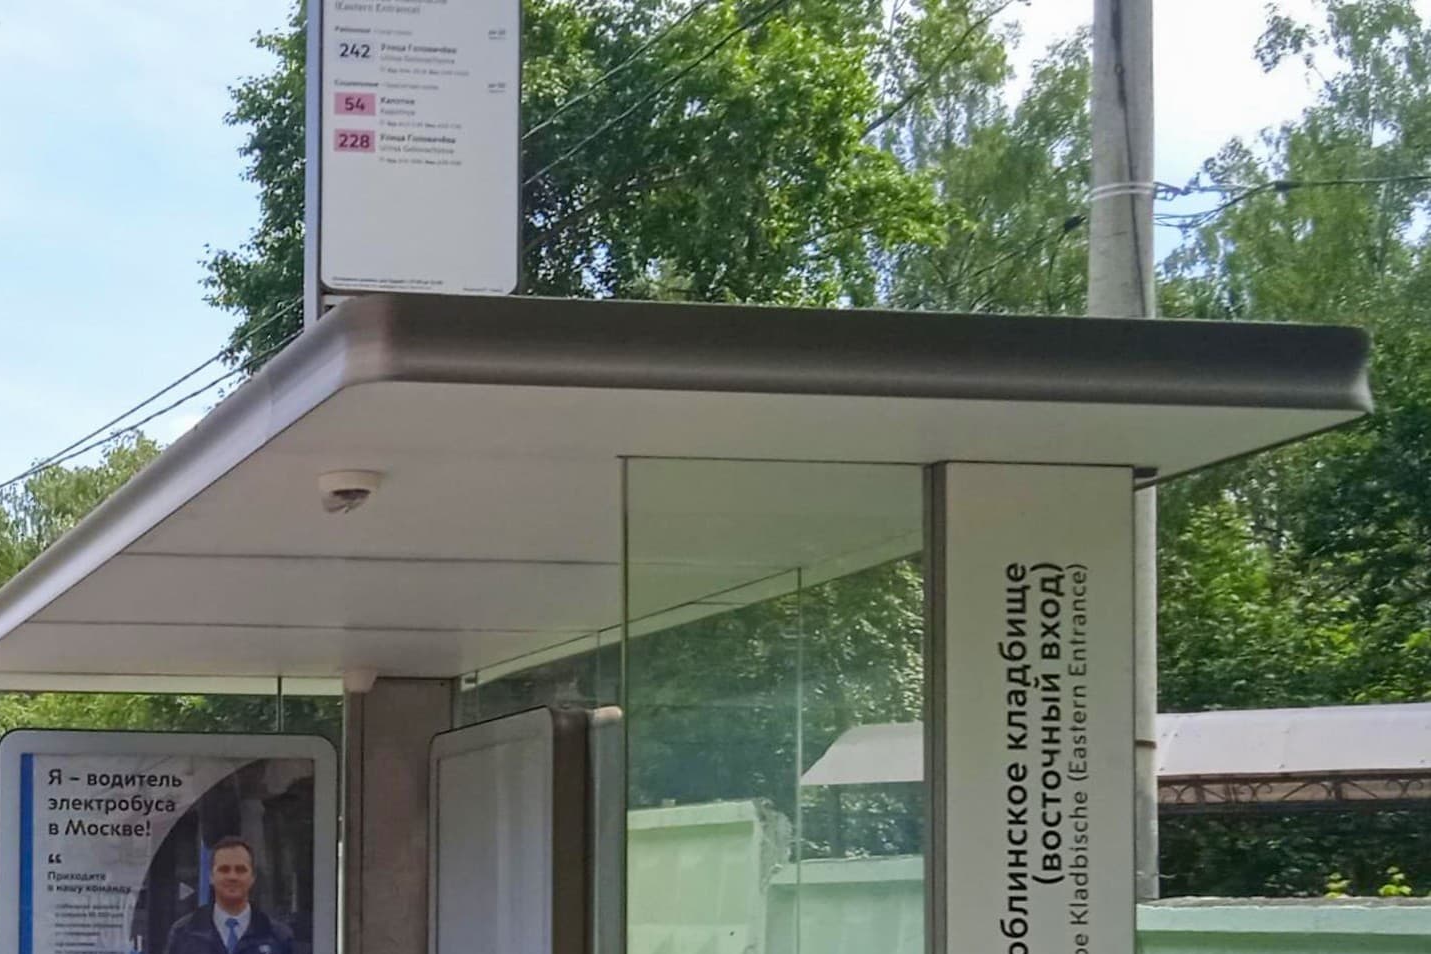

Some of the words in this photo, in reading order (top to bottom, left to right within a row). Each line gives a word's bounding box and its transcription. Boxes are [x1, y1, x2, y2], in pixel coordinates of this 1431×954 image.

[339, 43, 371, 58] 242
[344, 97, 365, 112] 54
[338, 133, 371, 149] 228
[1029, 562, 1065, 660] вход)
[1066, 564, 1088, 677] Entrance)
[998, 562, 1031, 750] кладбище
[1067, 684, 1089, 781] (Eastern
[48, 768, 62, 785] Я
[87, 773, 183, 788] водитель
[1032, 673, 1065, 884] (восточный
[48, 794, 176, 815] электробуса
[48, 822, 59, 835] в
[65, 819, 151, 837] Москве!
[1068, 791, 1089, 926] Kladbische
[47, 871, 106, 882] Приходите
[56, 885, 83, 895] нашу
[85, 886, 131, 895] команду
